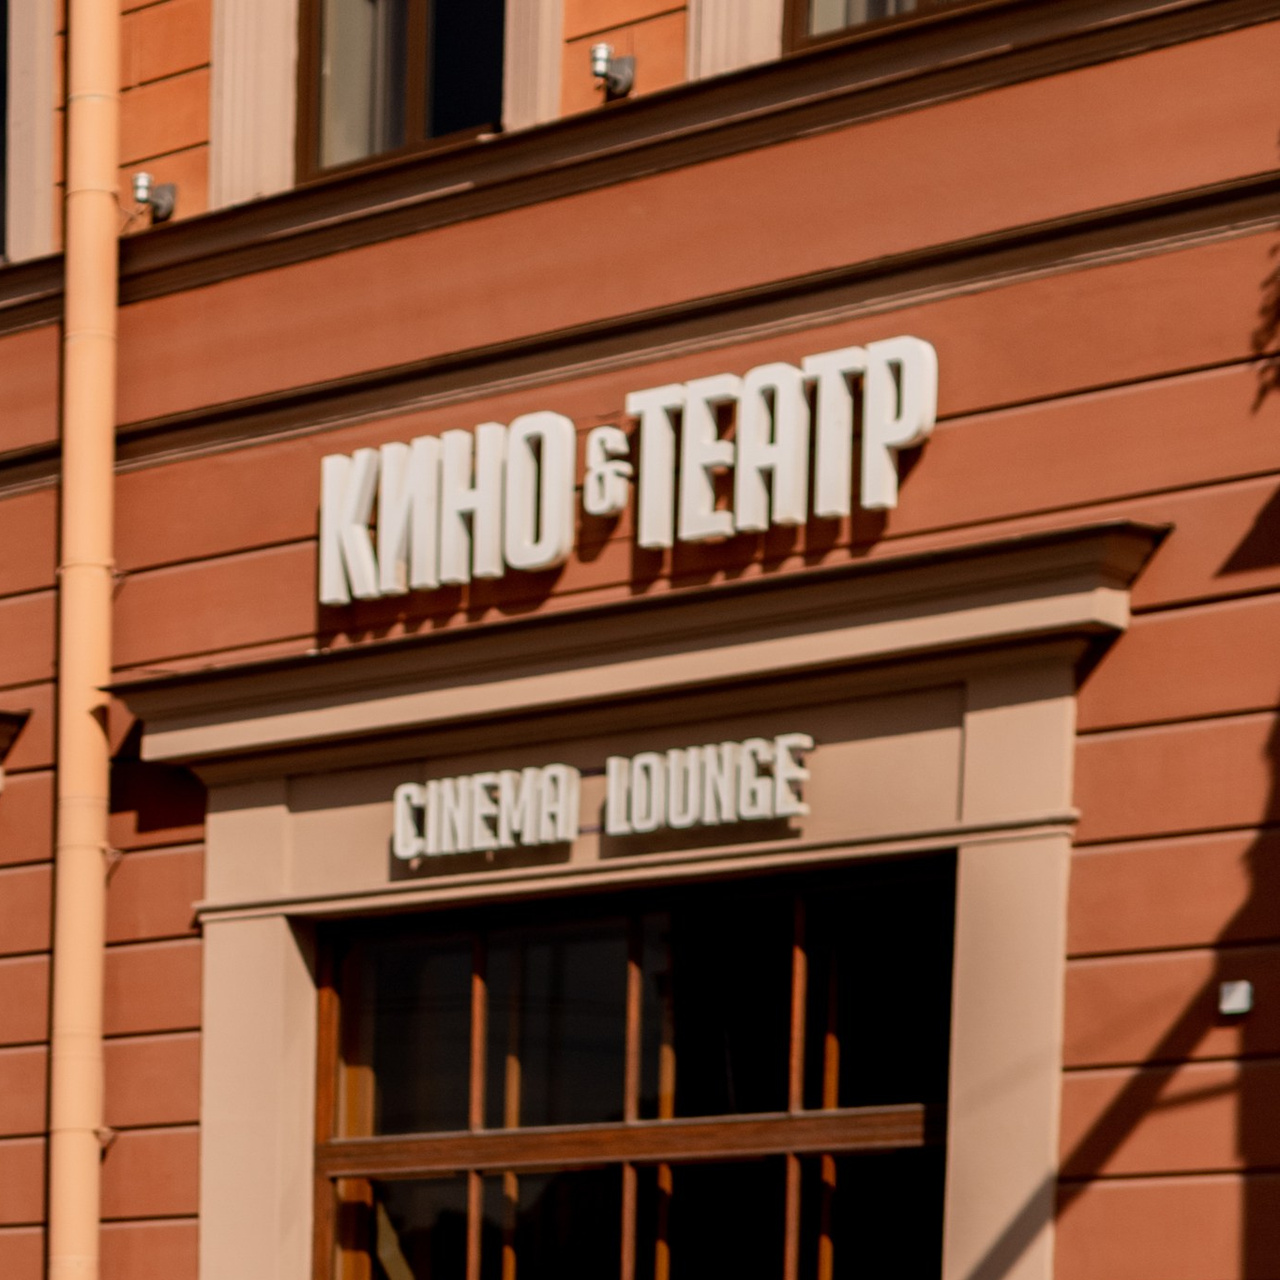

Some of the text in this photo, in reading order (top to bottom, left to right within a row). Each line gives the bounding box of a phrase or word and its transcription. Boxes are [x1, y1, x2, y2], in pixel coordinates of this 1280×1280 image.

[321, 411, 576, 605] КИНО
[626, 335, 938, 550] ТЕАТР
[393, 732, 814, 860] CINEMA LOUNGE
